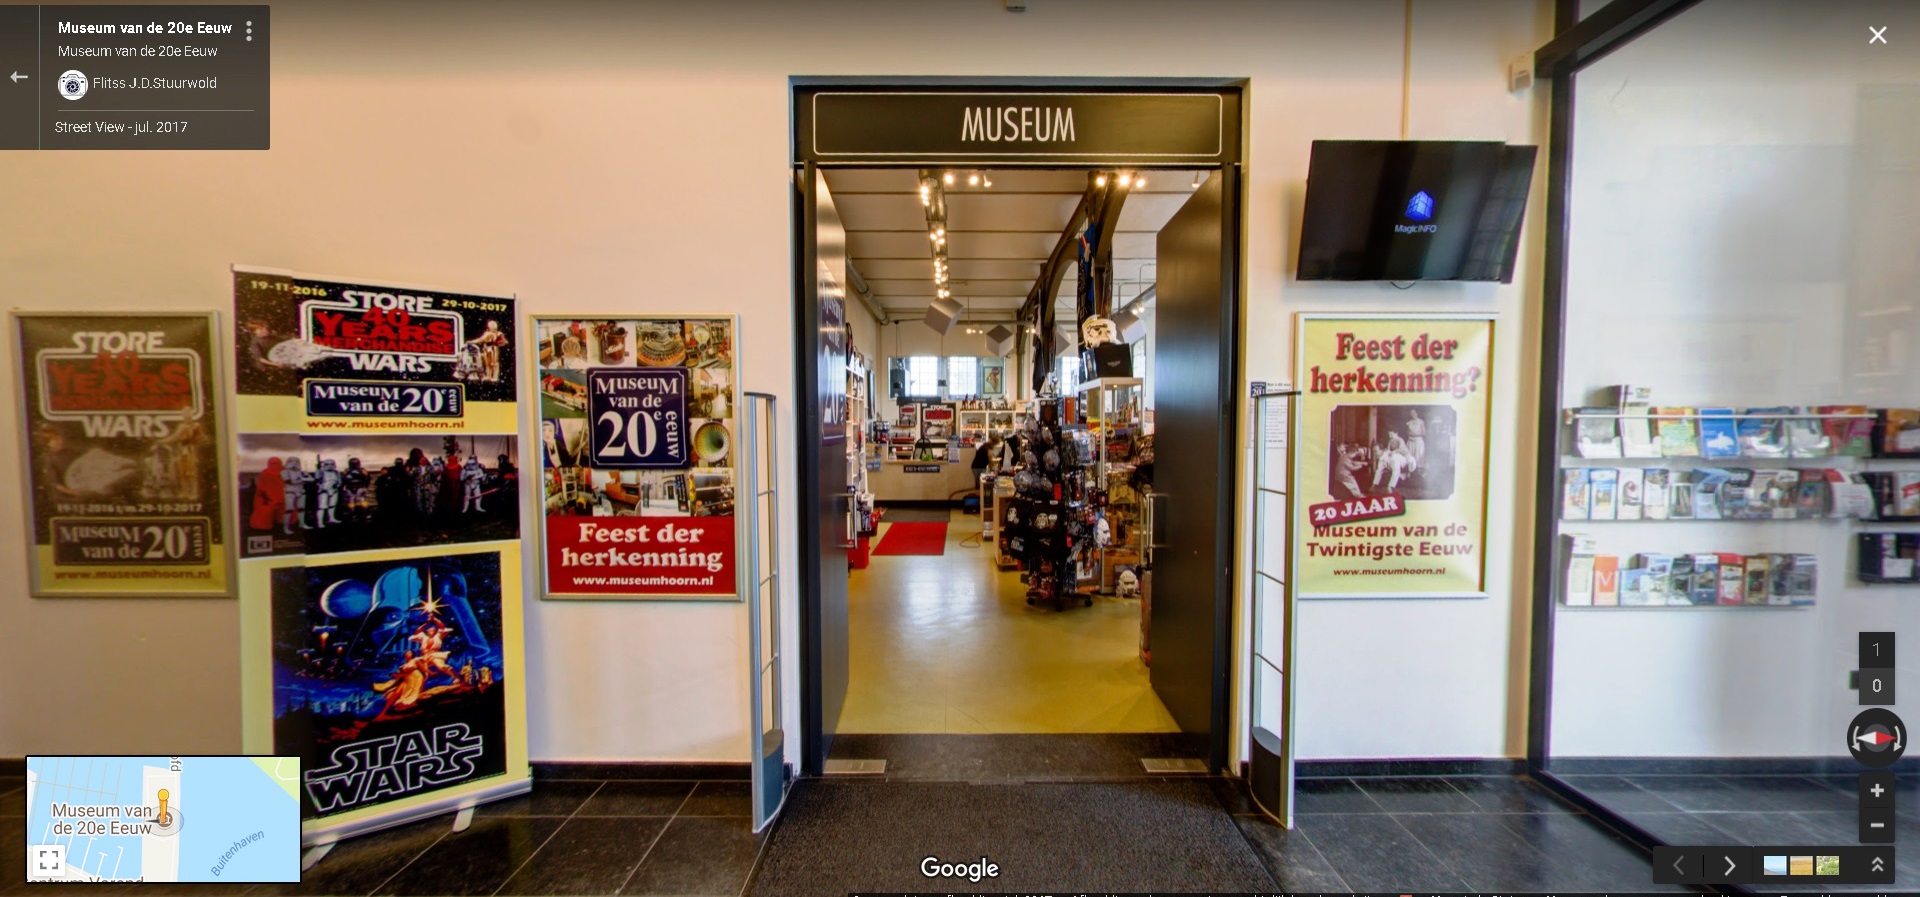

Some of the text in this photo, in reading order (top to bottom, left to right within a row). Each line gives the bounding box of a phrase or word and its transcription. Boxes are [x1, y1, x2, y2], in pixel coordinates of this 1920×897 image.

[961, 106, 1075, 141] MUSEUM
[250, 280, 327, 297] 19-11-2016
[342, 290, 434, 312] STORE
[442, 299, 507, 312] 29-10-2017
[314, 311, 453, 344] YEARS
[362, 307, 410, 327] 40
[72, 332, 165, 353] STORE
[314, 336, 453, 354] MERCHANDISE
[1336, 333, 1458, 360] Feest der
[350, 354, 432, 373] WARS
[1310, 366, 1481, 398] herkenning?
[339, 401, 373, 412] van
[377, 401, 400, 412] de
[449, 389, 457, 413] eeuw
[609, 394, 662, 408] van de
[81, 416, 170, 438] WARS
[665, 411, 680, 458] eeuw
[1315, 496, 1398, 521] 20 JAAR
[578, 523, 704, 543] Feest der
[1314, 523, 1467, 537] Museum van de
[82, 547, 114, 559] van
[118, 544, 140, 559] de
[562, 547, 723, 572] herkenning
[1306, 542, 1473, 560] Twintigste Eeuw
[573, 576, 713, 586] www.museumhoorn.nl
[305, 722, 482, 783] STAR
[306, 746, 482, 813] WARS
